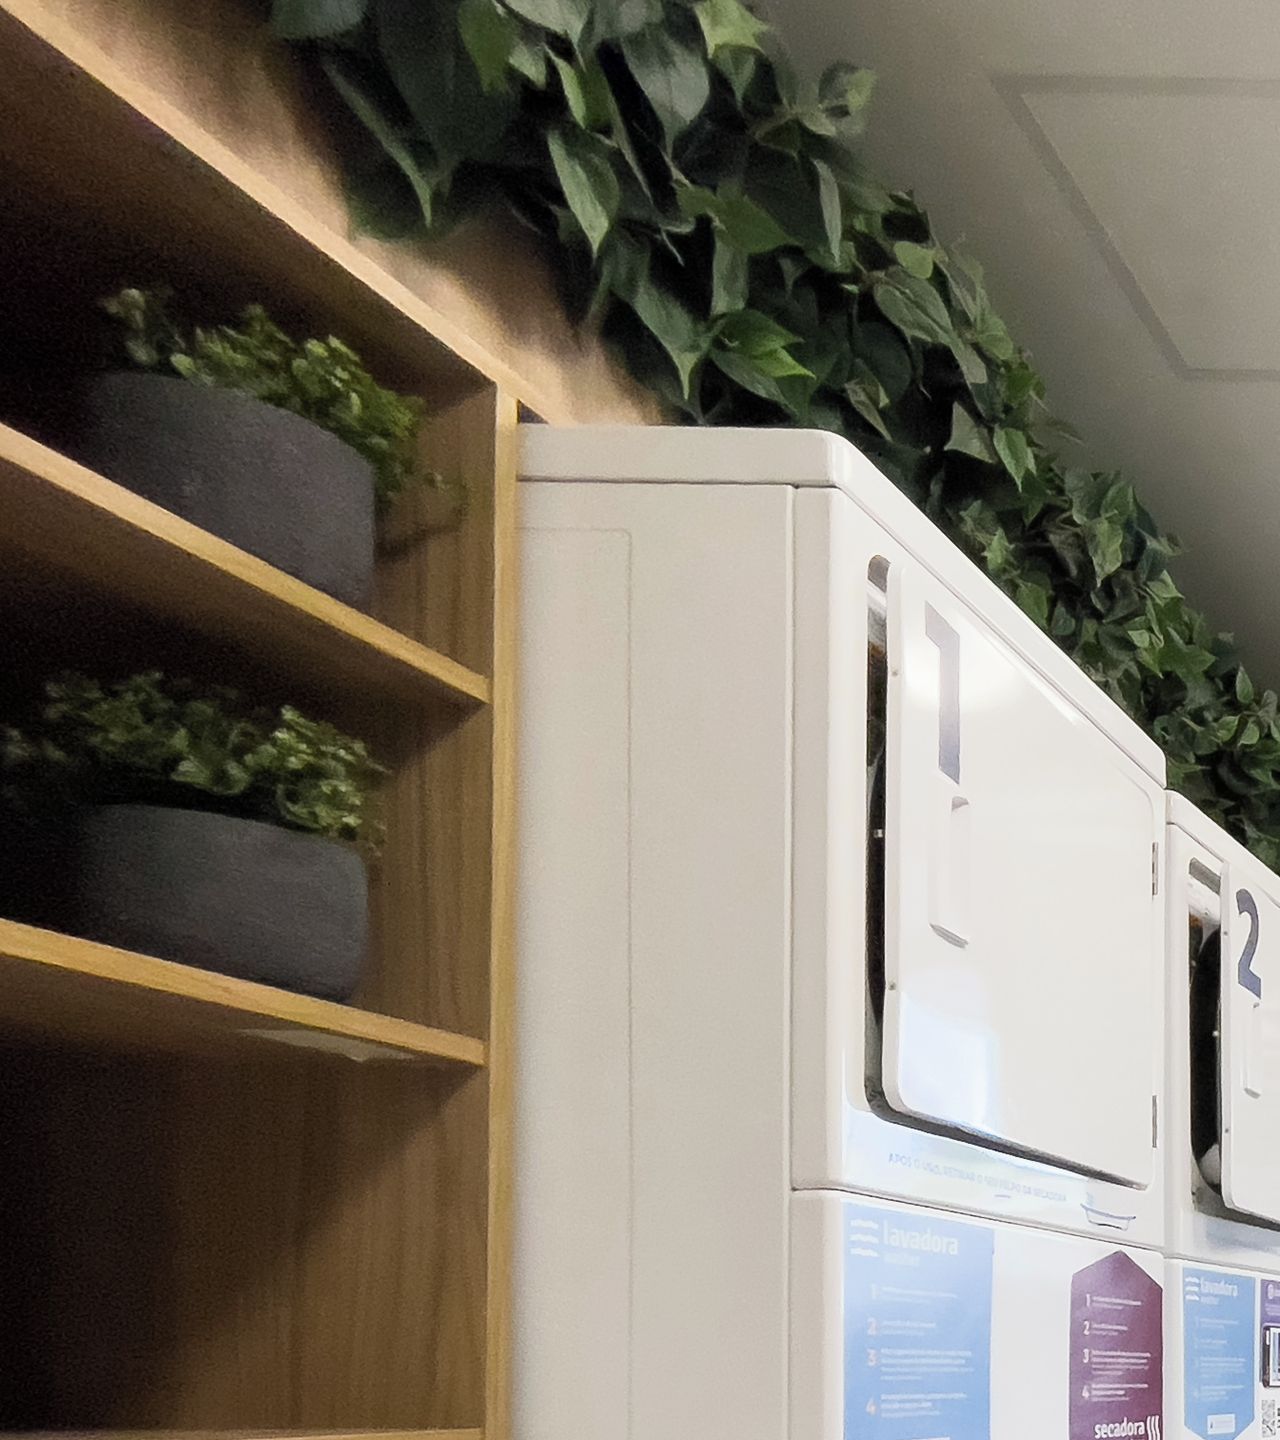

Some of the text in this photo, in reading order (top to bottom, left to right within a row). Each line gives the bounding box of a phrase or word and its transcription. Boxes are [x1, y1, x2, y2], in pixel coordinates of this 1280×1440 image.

[924, 600, 961, 785] 1
[1235, 887, 1261, 1000] 2
[883, 1219, 959, 1255] lavadora
[1083, 1321, 1090, 1336] 2
[1083, 1349, 1090, 1364] 3
[1082, 1385, 1090, 1399] 4
[1094, 1416, 1146, 1440] secadora
